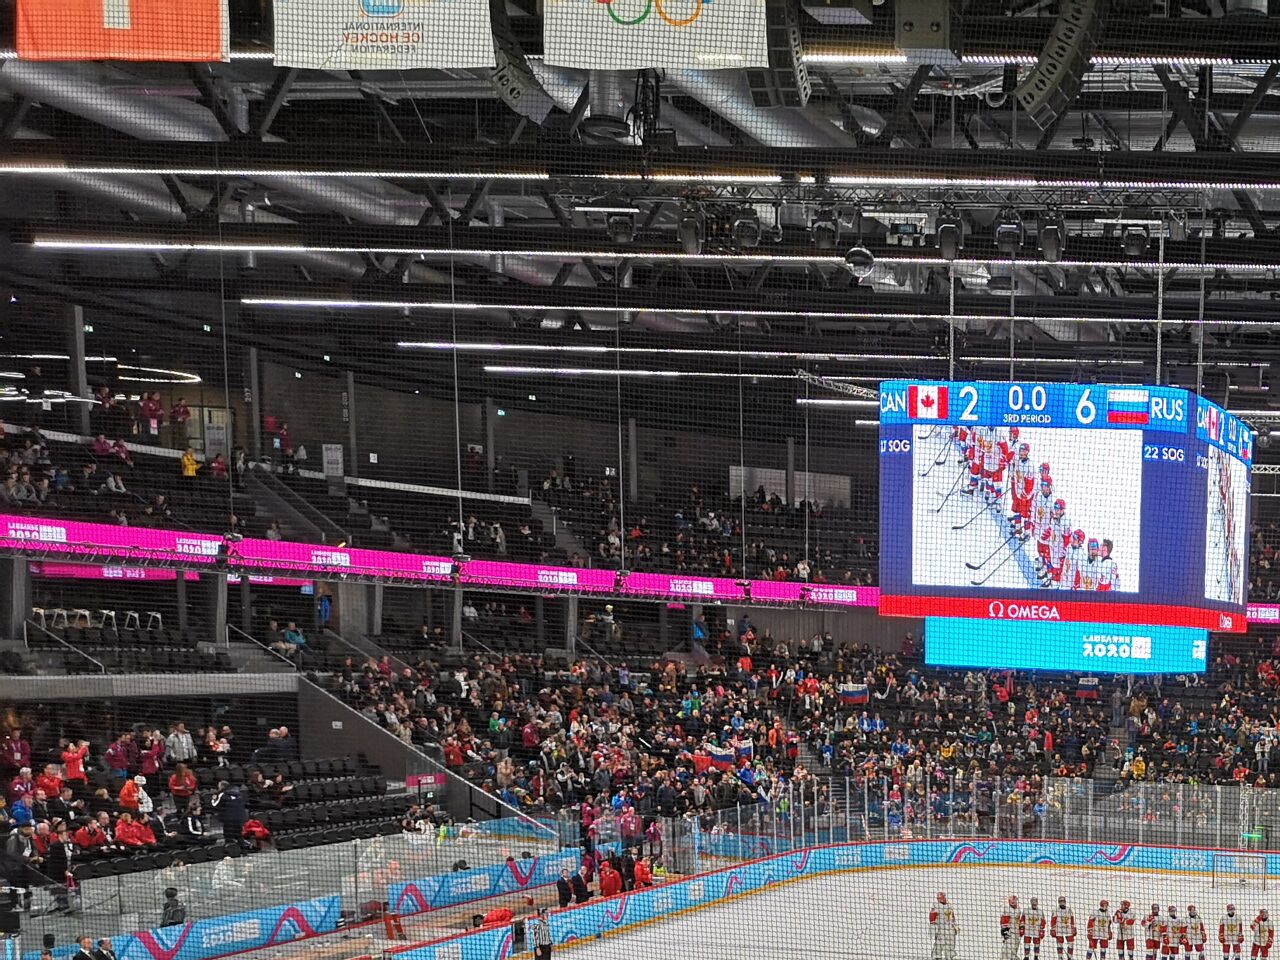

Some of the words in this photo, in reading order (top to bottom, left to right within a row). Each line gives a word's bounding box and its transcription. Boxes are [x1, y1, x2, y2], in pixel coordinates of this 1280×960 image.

[880, 391, 906, 412] CAN
[959, 386, 978, 421] 2
[1009, 385, 1047, 411] 0.0
[1076, 388, 1096, 425] 6
[1151, 397, 1183, 421] RUS
[1003, 414, 1019, 423] 3RD
[1021, 415, 1051, 424] PERIOD
[888, 439, 910, 452] SOG
[1144, 446, 1159, 459] 22
[1162, 448, 1185, 461] SOG
[1008, 605, 1060, 619] OMEGA
[1083, 643, 1130, 658] 2020
